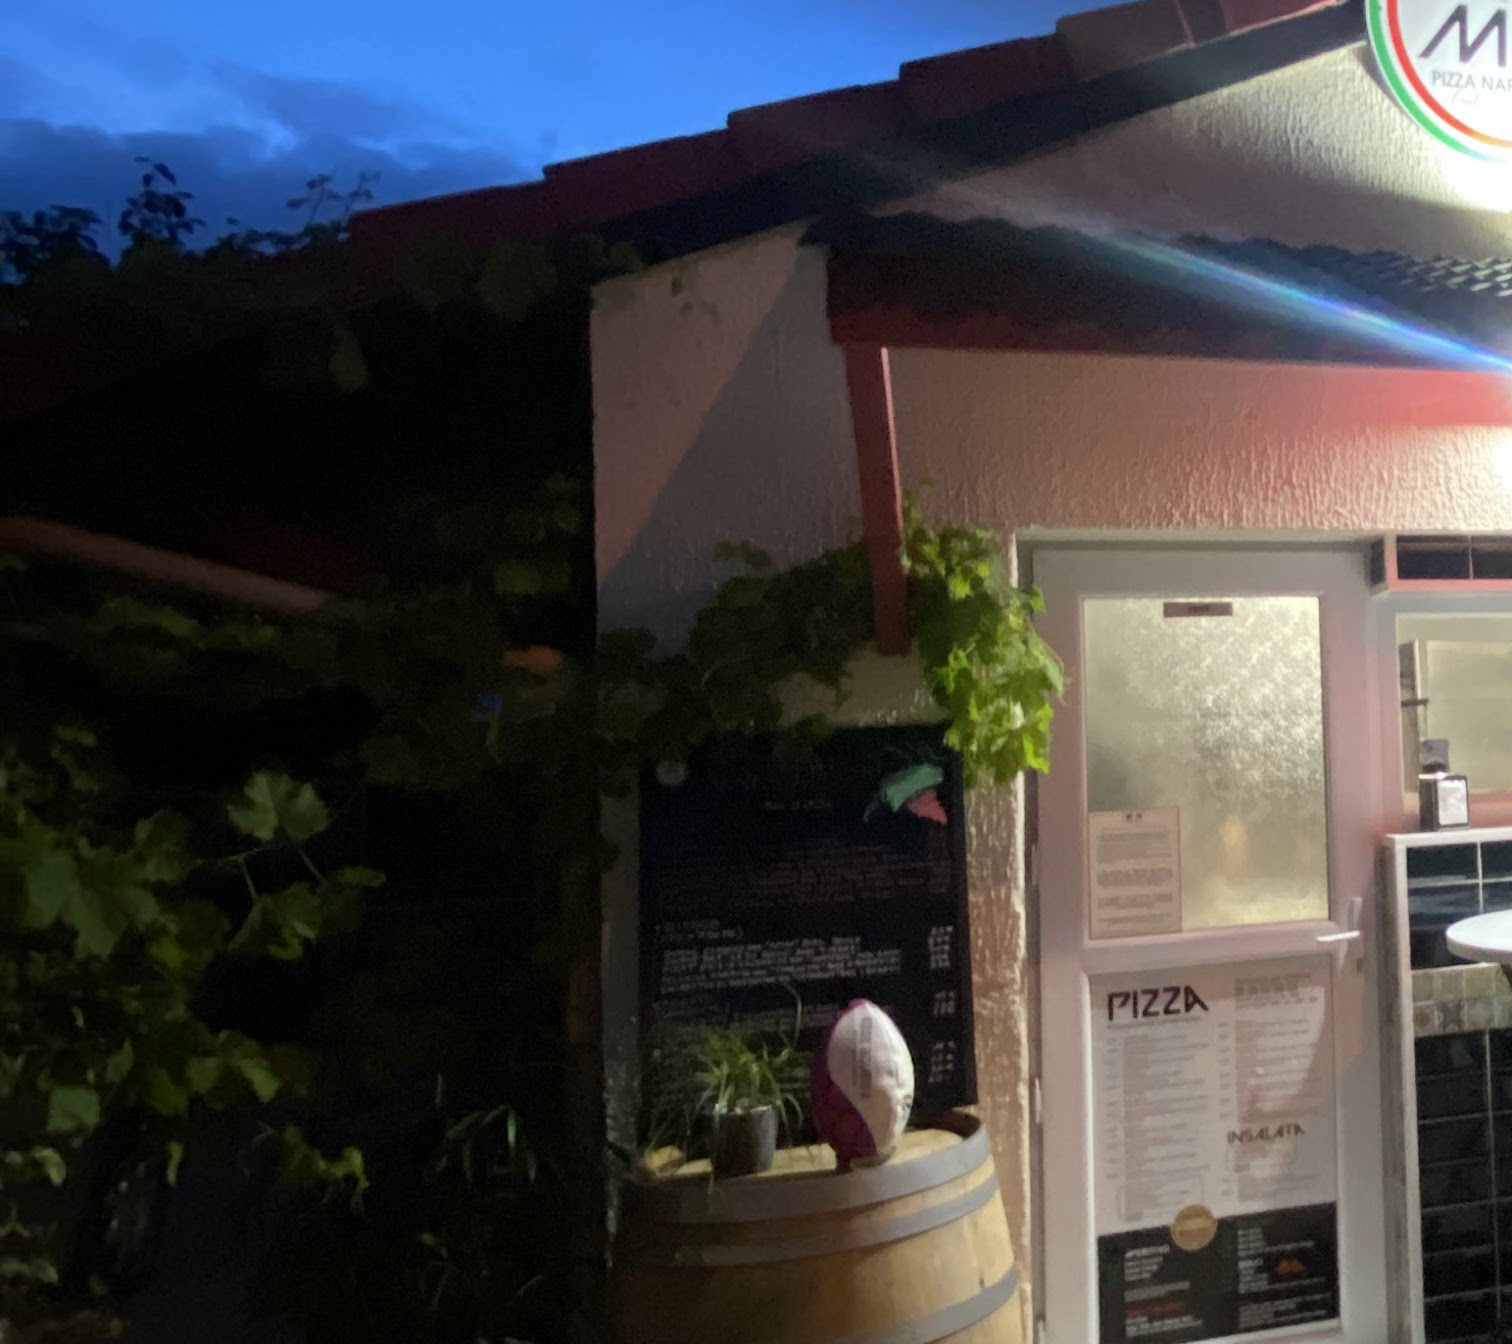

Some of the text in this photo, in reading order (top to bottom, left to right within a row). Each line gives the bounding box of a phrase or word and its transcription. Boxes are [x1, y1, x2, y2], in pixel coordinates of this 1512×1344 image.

[1431, 69, 1476, 89] PIZZA
[1107, 985, 1209, 1022] PIZZA
[1227, 1122, 1305, 1145] INSALATA
